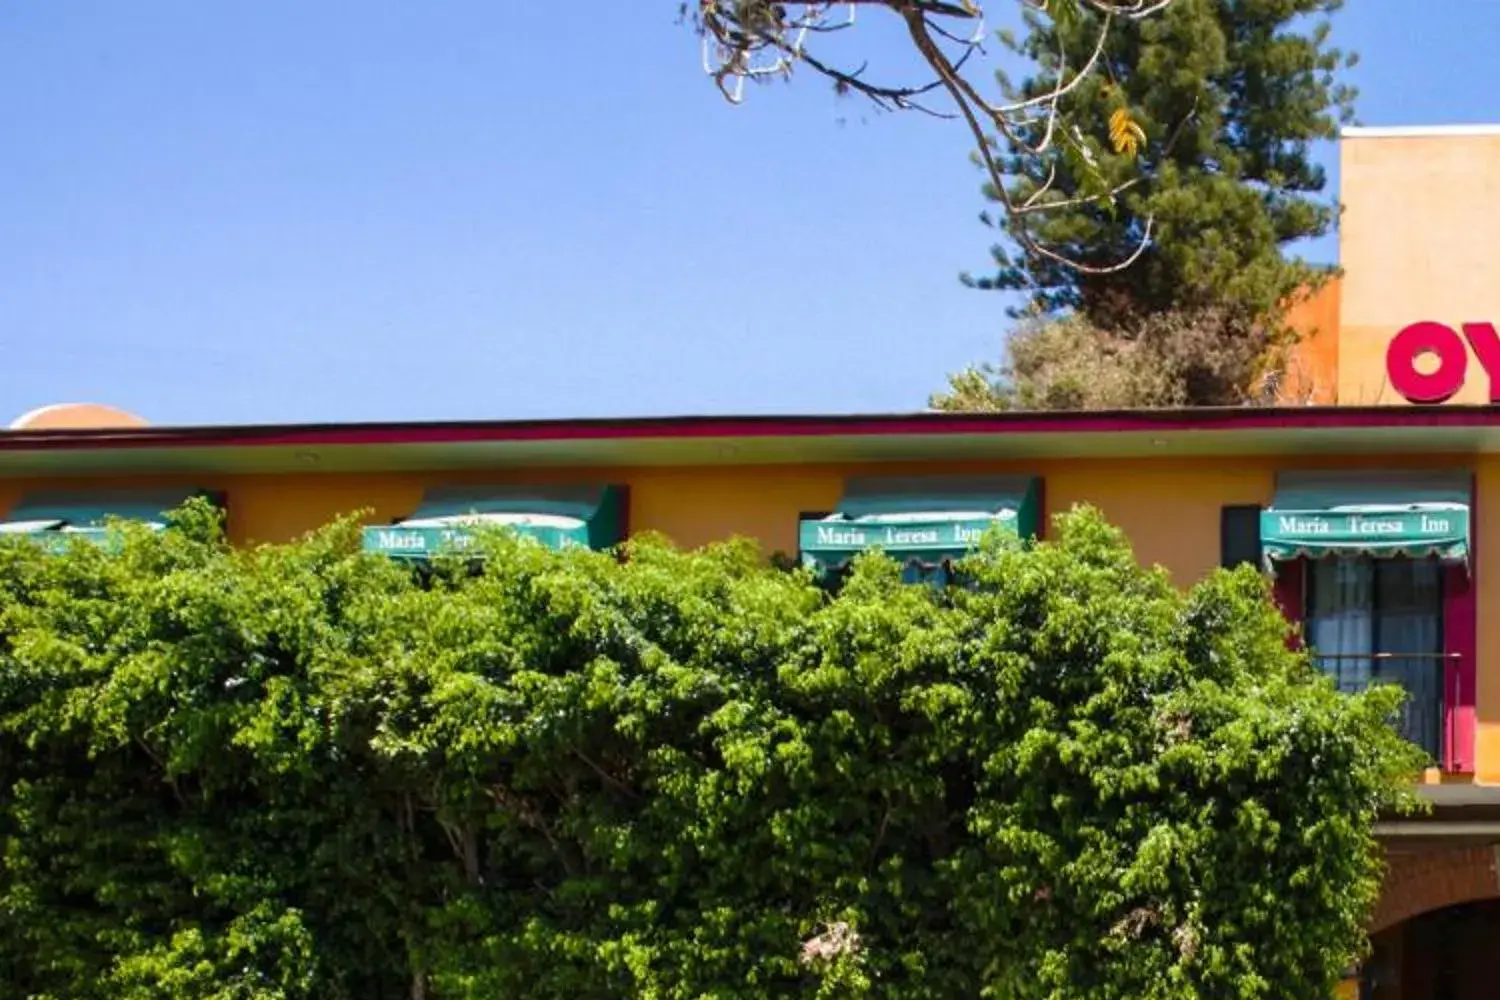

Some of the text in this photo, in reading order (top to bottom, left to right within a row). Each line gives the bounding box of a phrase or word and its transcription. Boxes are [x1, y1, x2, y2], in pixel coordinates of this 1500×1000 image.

[884, 526, 937, 544] Teresa
[954, 524, 982, 543] Inn
[1347, 515, 1403, 534] Teresa
[1421, 514, 1449, 533] Inn
